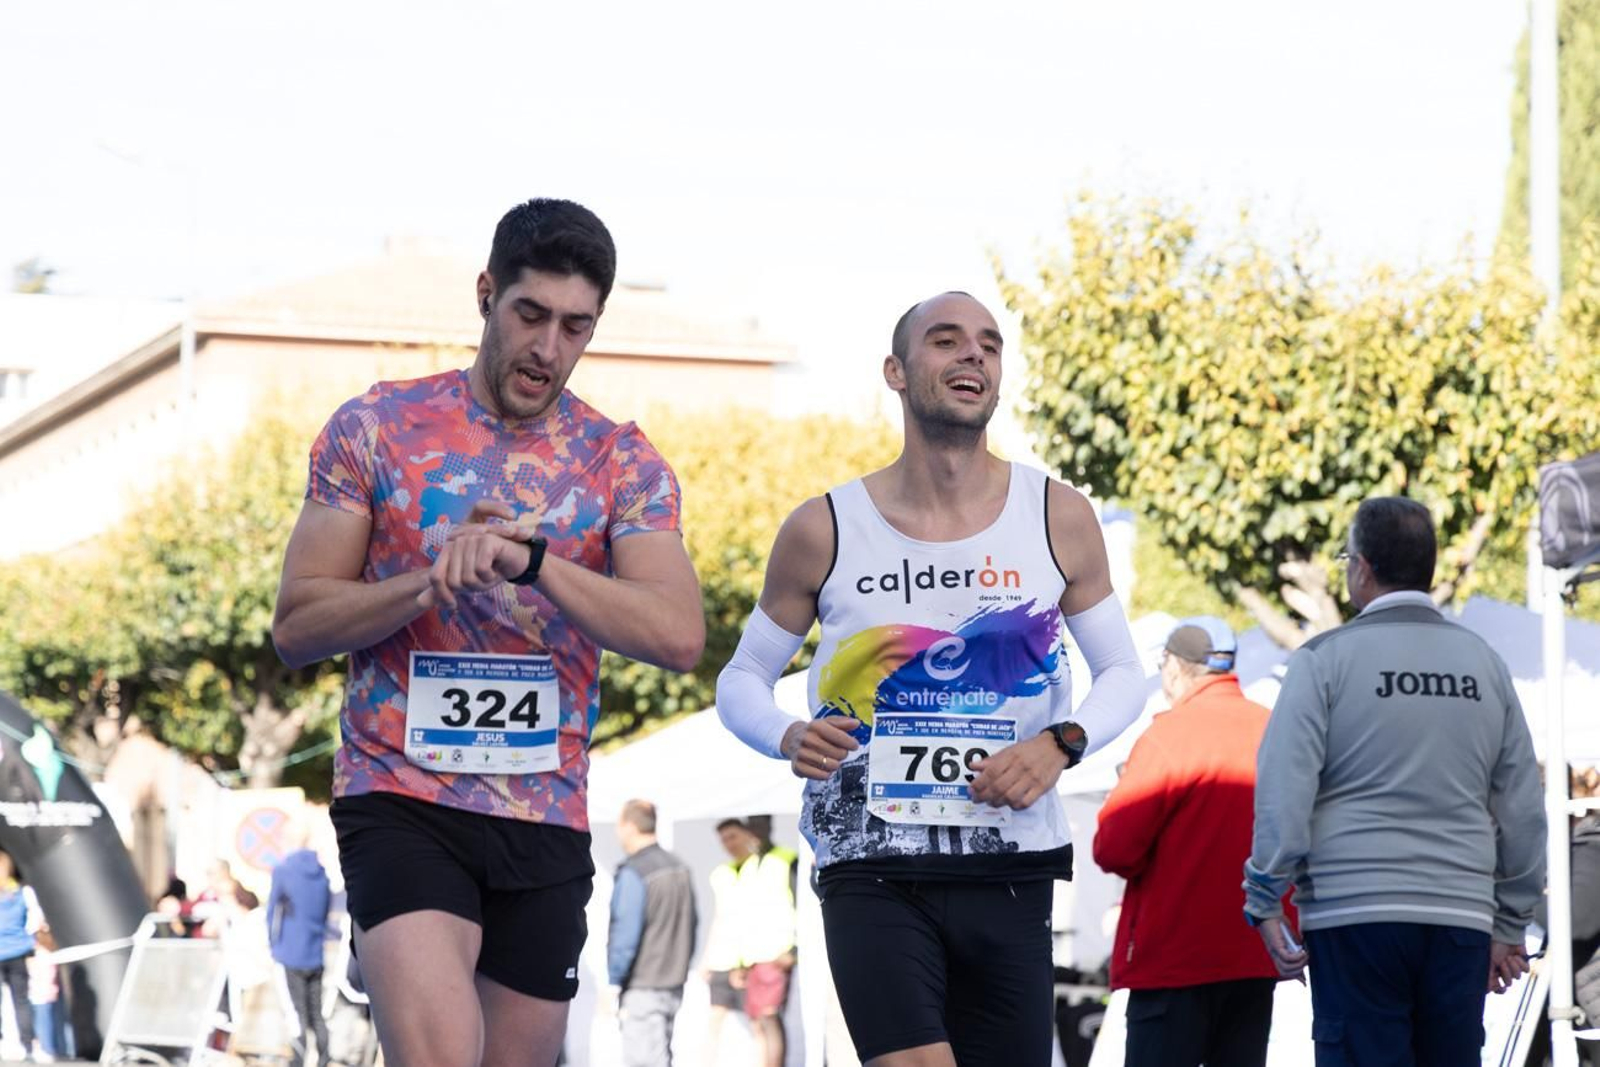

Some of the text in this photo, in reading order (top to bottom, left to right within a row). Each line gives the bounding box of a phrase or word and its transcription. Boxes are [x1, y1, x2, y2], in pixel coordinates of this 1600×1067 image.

[856, 555, 1021, 604] calderón
[978, 594, 1002, 602] desde
[896, 685, 999, 707] entrénate
[1376, 671, 1481, 701] Joma
[440, 688, 540, 729] 324
[899, 746, 990, 784] 769
[931, 785, 959, 795] JAIME
